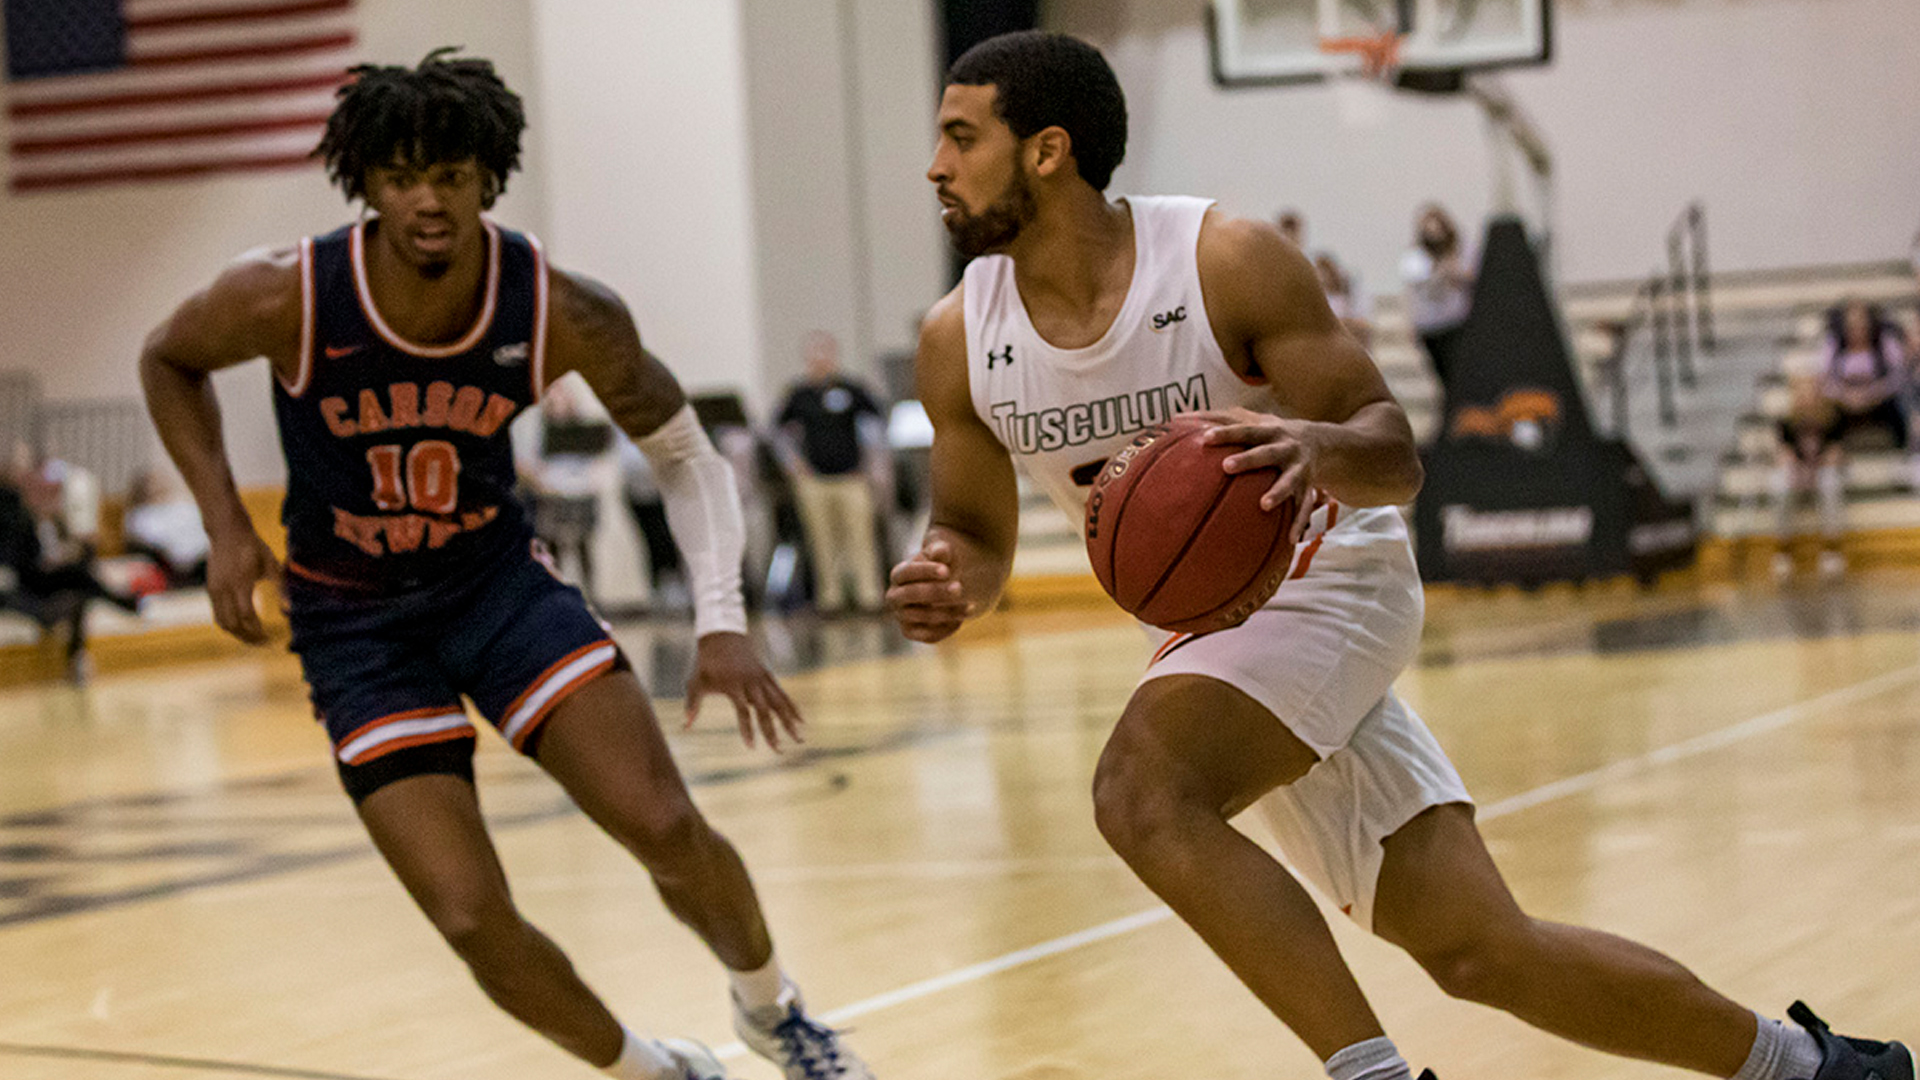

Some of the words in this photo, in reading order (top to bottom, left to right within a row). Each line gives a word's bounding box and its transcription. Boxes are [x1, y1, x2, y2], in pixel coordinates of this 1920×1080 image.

[1152, 306, 1188, 330] SAC
[319, 380, 516, 438] CARSON
[990, 372, 1211, 455] TUSCULUM
[365, 439, 461, 515] 10
